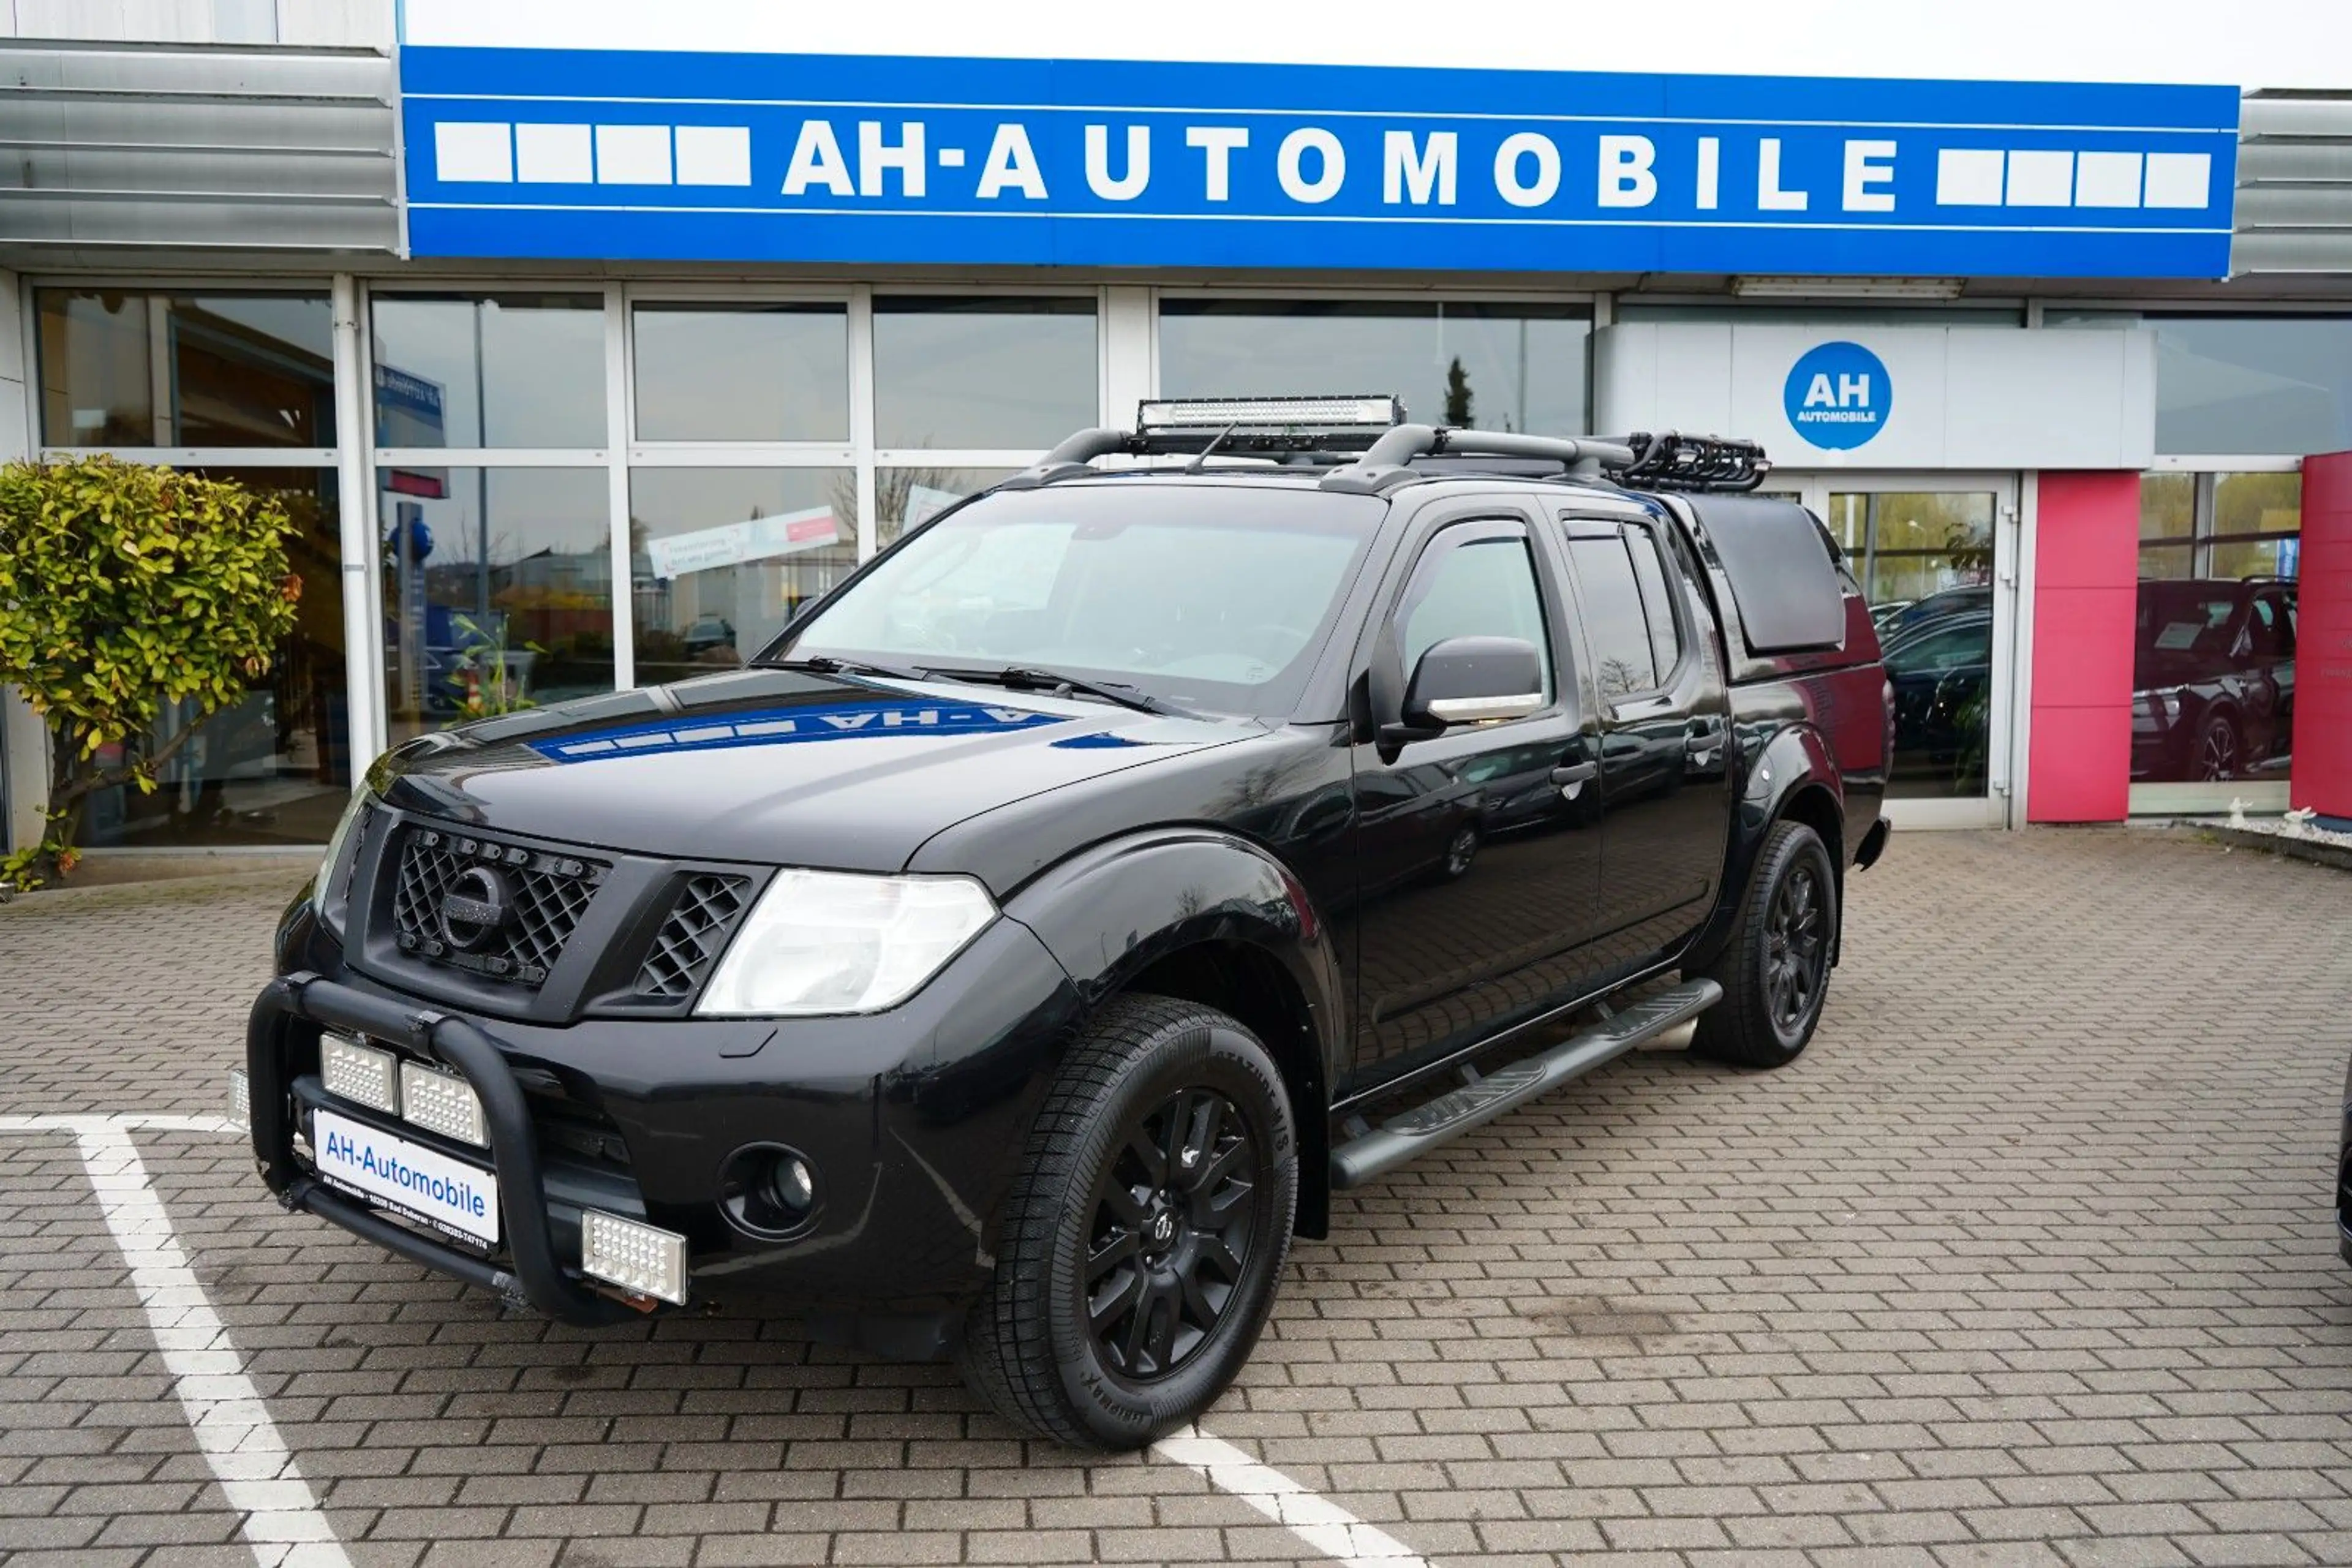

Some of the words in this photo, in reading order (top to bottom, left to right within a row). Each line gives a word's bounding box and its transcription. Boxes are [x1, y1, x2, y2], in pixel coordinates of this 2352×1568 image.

[781, 120, 1897, 212] AH-AUTOMOBILE
[1797, 412, 1876, 423] AUTOMOBILE
[1803, 374, 1870, 407] AH
[326, 1131, 485, 1218] AH-Automobile
